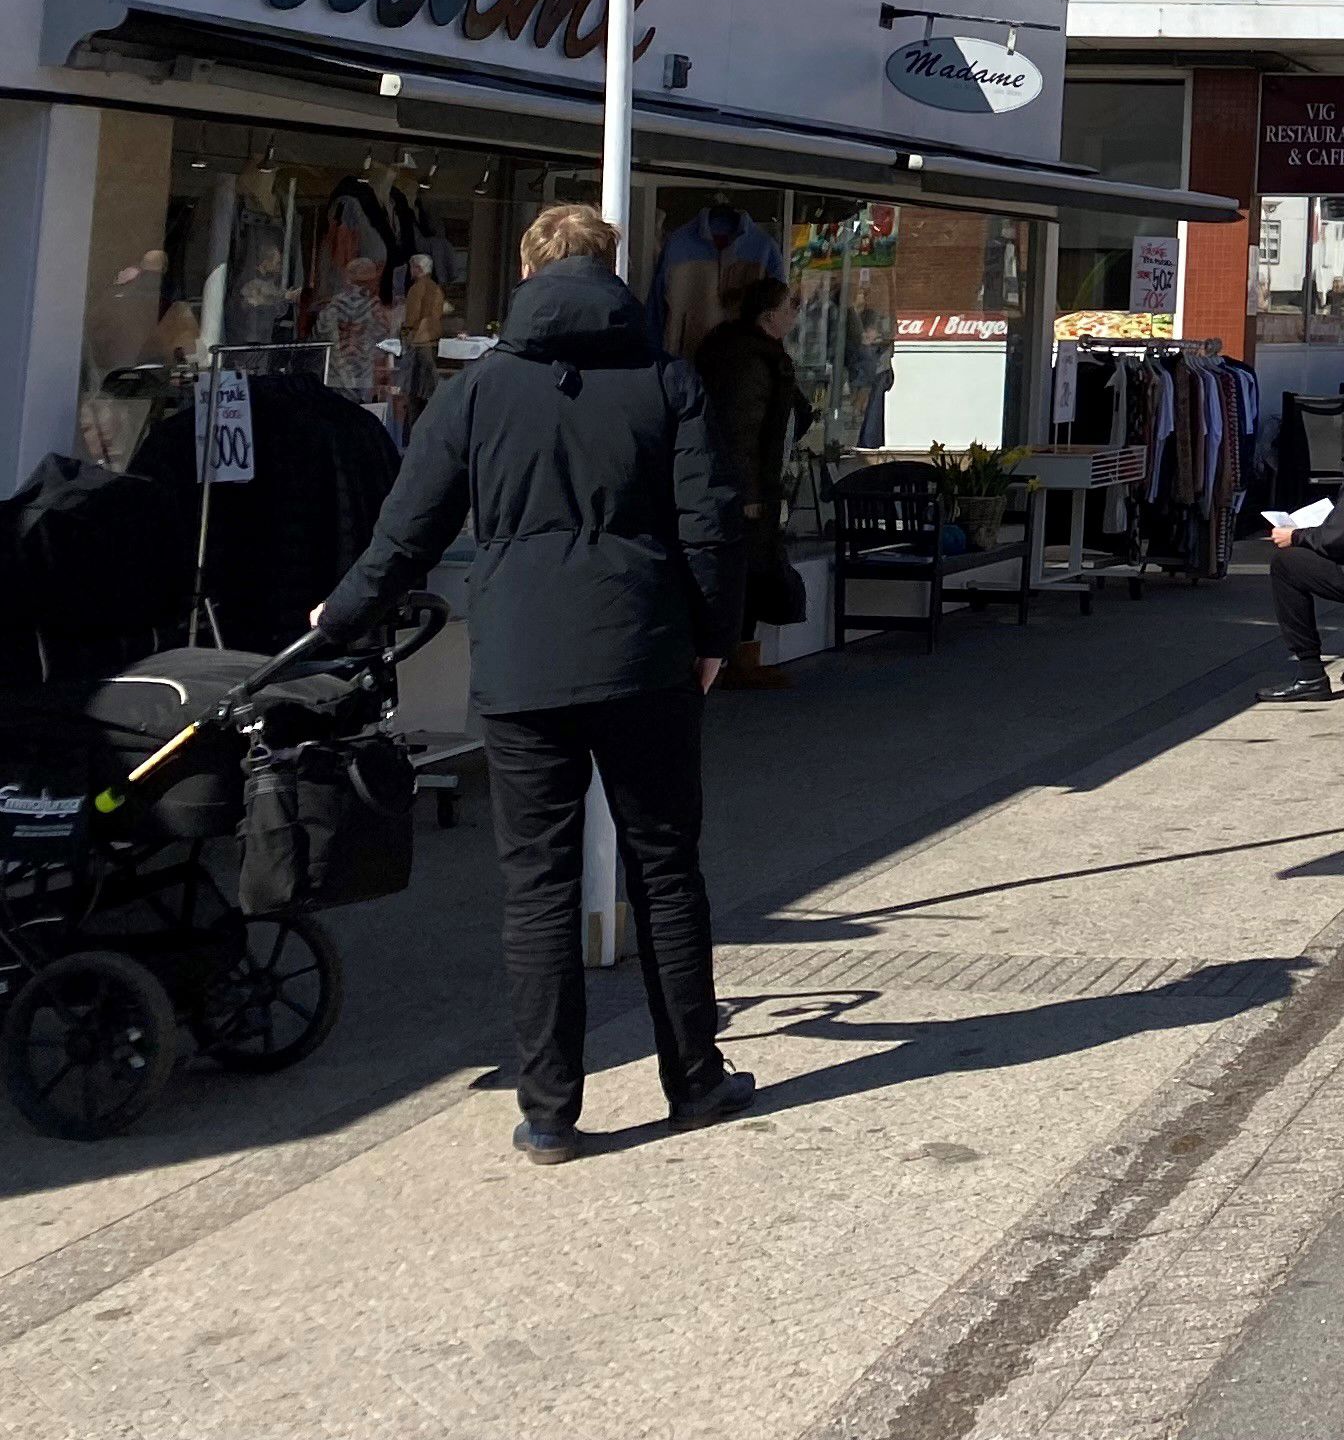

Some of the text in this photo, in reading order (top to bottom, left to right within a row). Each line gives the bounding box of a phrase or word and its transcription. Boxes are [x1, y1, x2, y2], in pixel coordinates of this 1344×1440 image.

[905, 49, 1026, 88] Madame
[1306, 103, 1336, 121] VIG
[1288, 148, 1302, 166] &
[944, 315, 1008, 340] Burge
